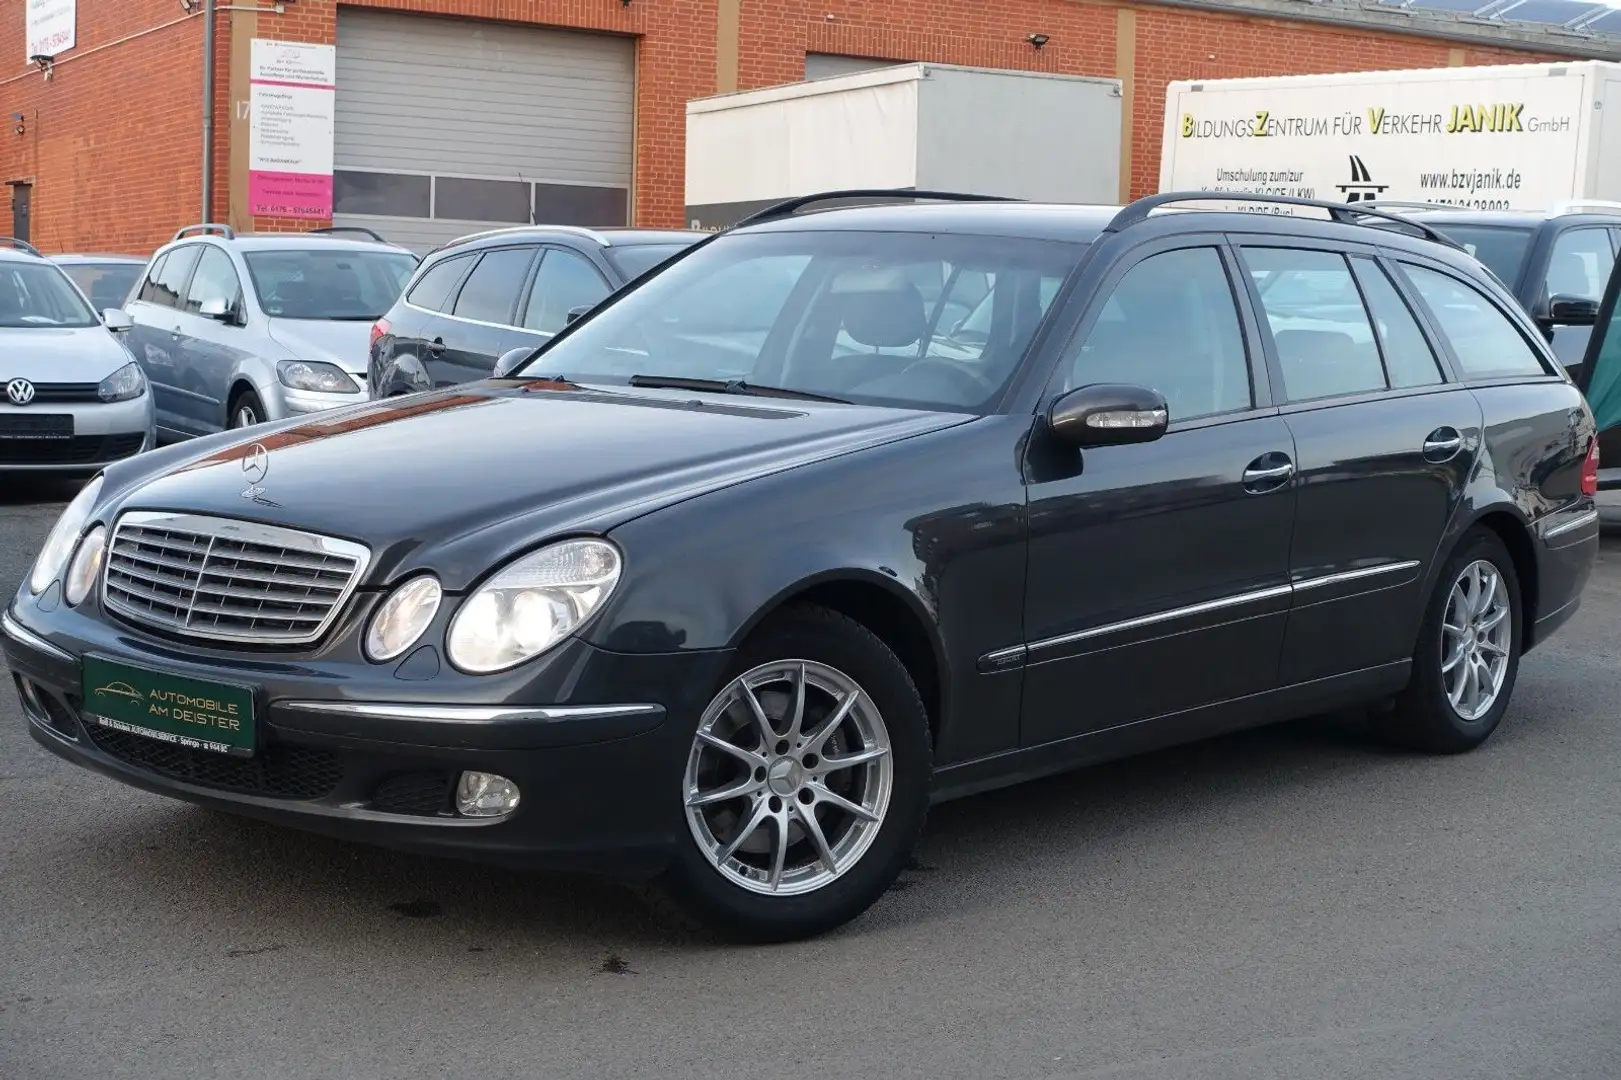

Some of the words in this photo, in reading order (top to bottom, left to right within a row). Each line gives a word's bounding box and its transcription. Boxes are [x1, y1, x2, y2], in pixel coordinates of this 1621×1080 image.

[1182, 111, 1328, 138] BILDUNGSZENTRUM
[1333, 112, 1362, 136] FÜR
[1367, 107, 1442, 135] VERKEHR
[1447, 103, 1524, 133] JANIK
[1528, 116, 1570, 133] GmbH
[1216, 167, 1268, 185] Umschulung
[1270, 169, 1304, 182] zum/zur
[1420, 168, 1521, 194] www.bzvjanik.de
[149, 688, 239, 715] AUTOMOBILE
[148, 703, 170, 717] AM
[173, 708, 240, 731] DEISTER
